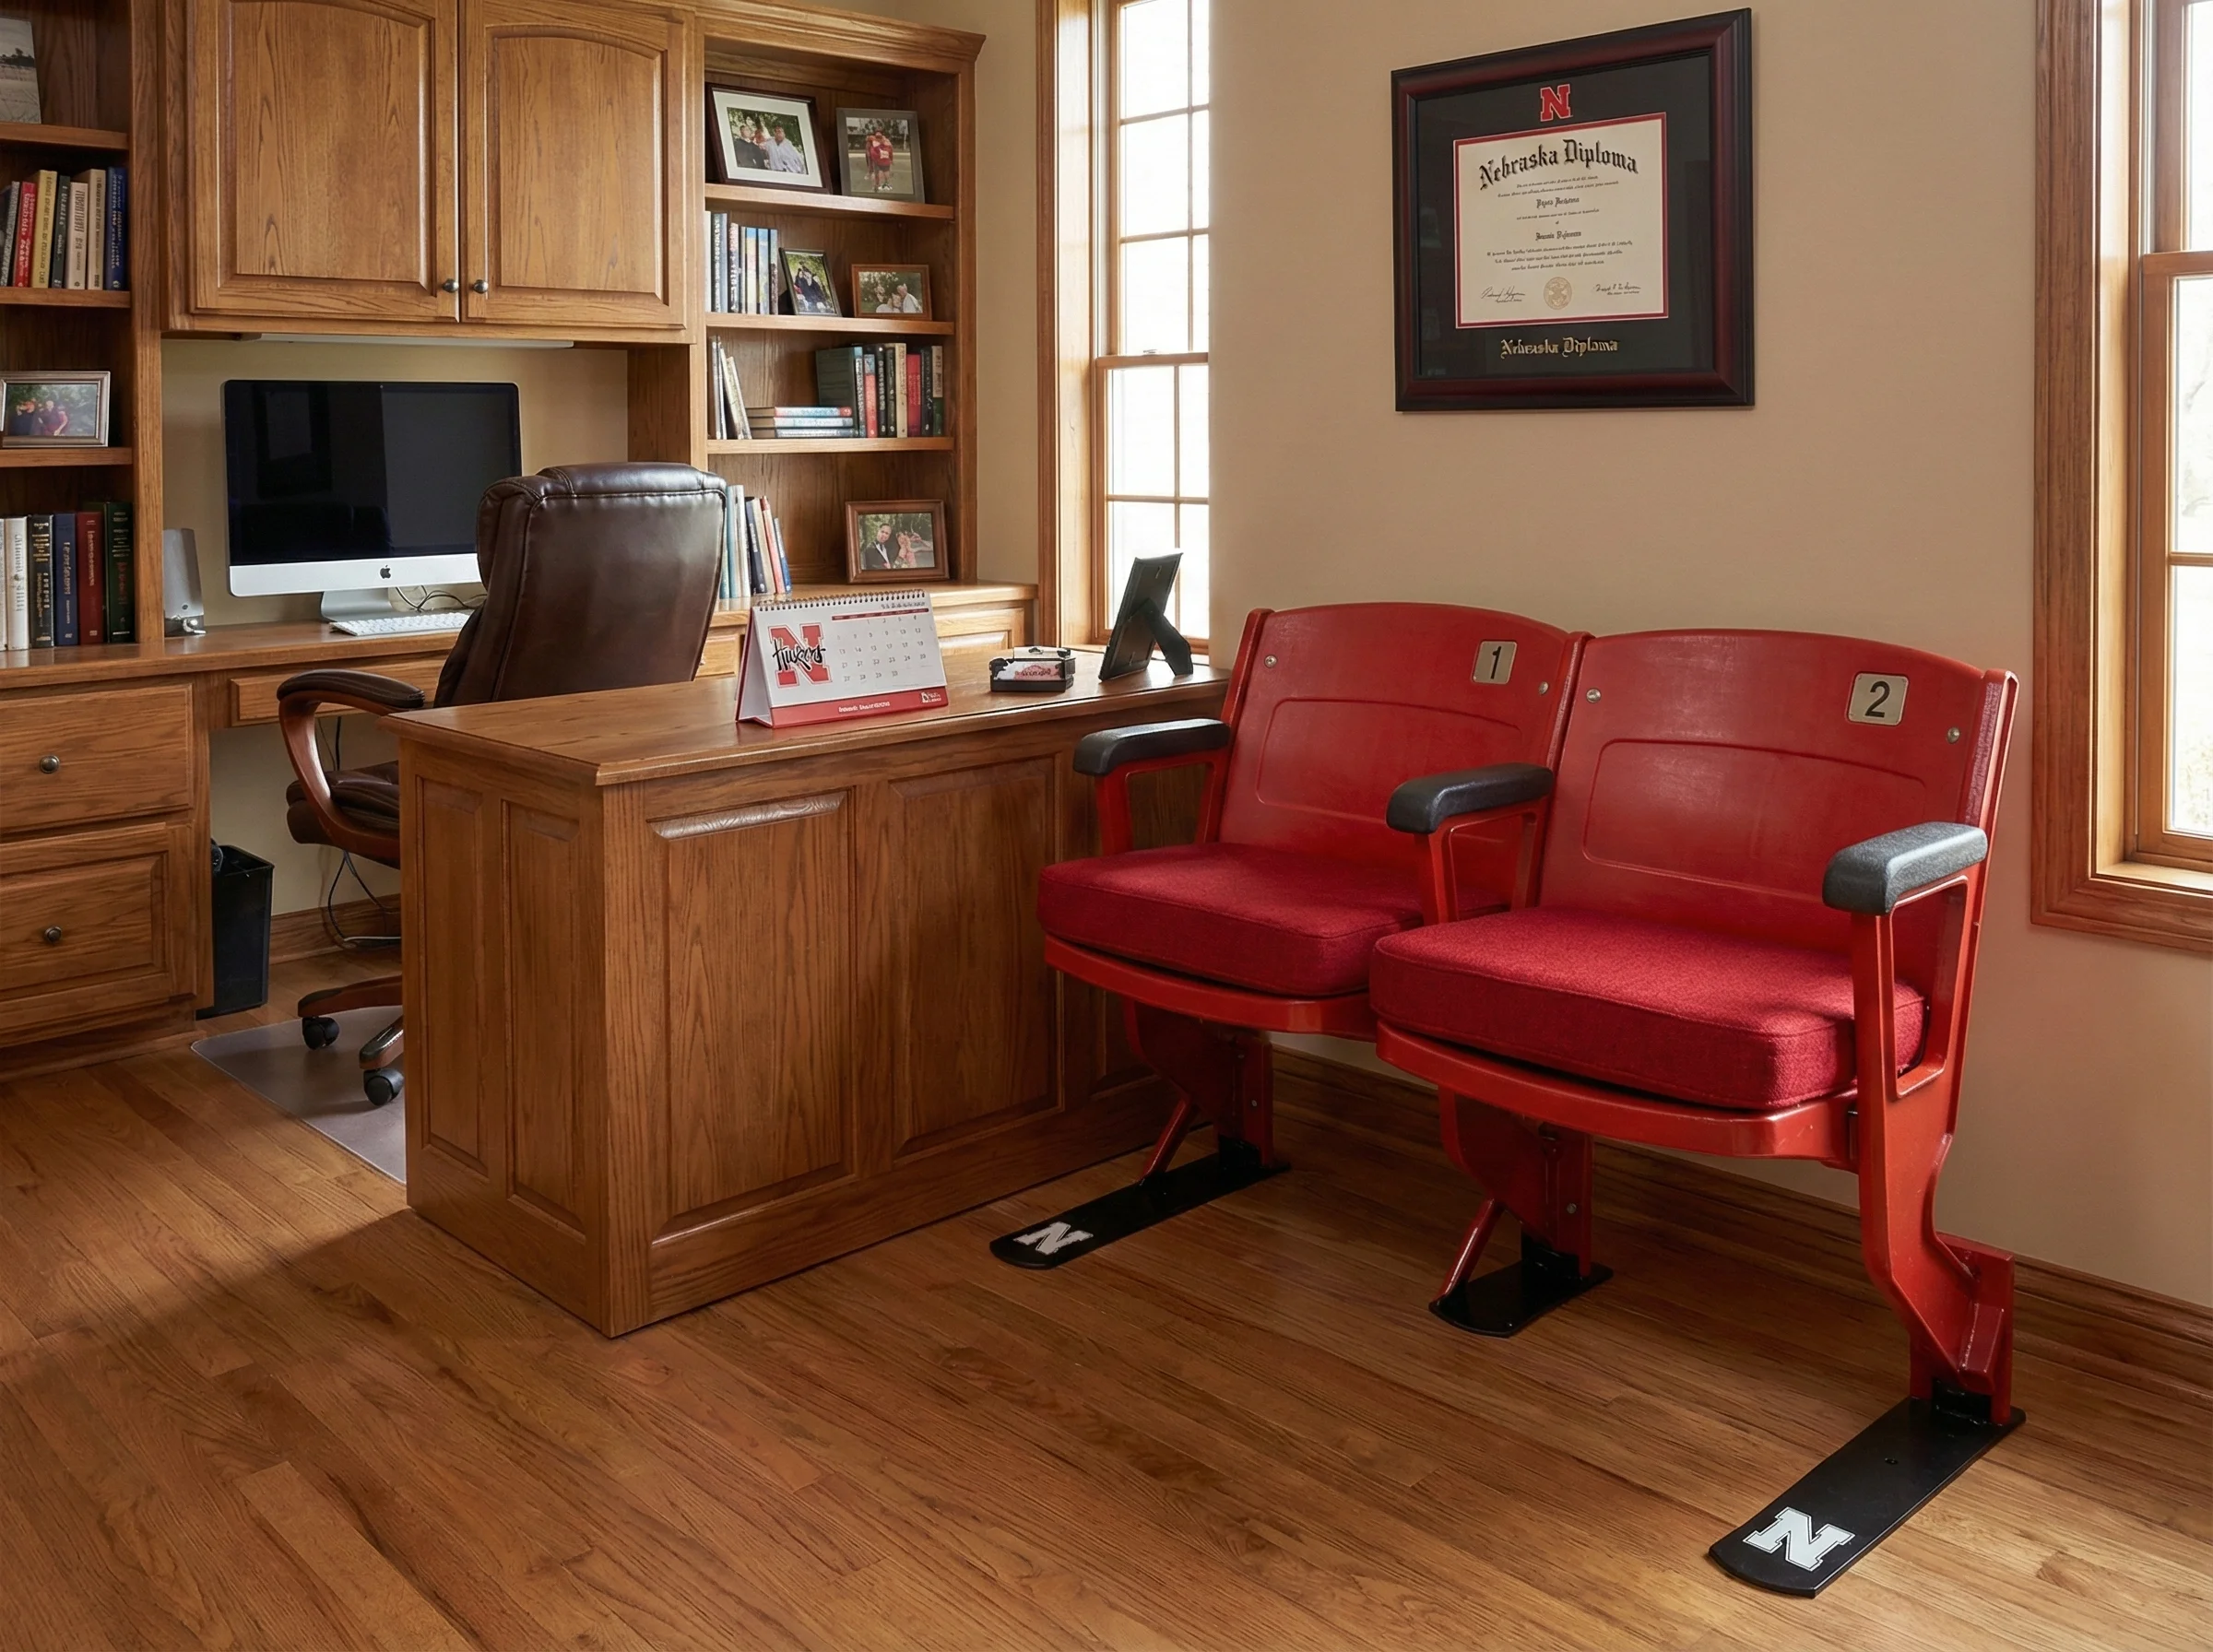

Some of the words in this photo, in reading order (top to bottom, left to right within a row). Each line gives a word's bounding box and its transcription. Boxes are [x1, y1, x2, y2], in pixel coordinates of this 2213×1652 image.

[1540, 83, 1572, 122] N
[1479, 144, 1559, 191] Nebraska
[1563, 138, 1639, 174] Diploma
[1490, 645, 1502, 679] 1
[1864, 680, 1890, 718] 2
[1012, 1221, 1095, 1256] N
[1742, 1506, 1856, 1572] N
